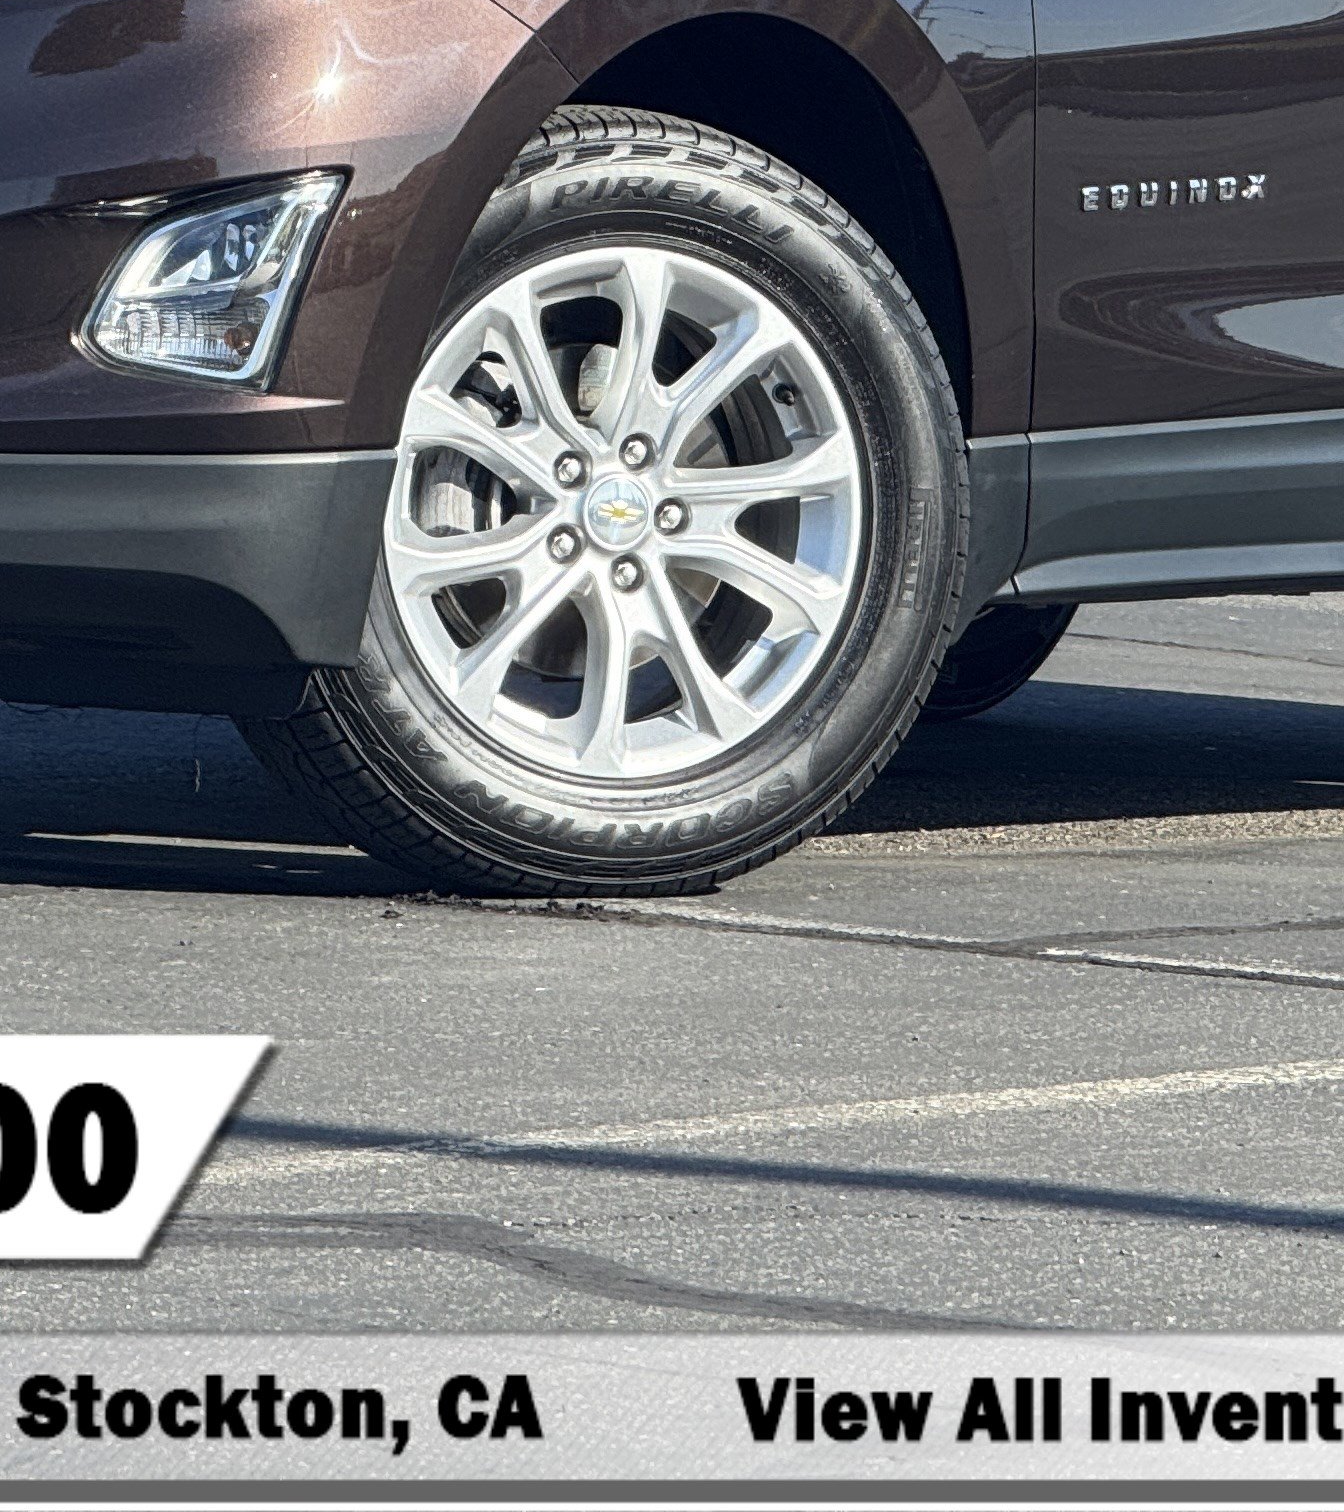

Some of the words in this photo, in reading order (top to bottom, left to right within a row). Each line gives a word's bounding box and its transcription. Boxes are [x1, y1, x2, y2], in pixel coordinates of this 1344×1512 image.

[549, 175, 795, 244] PIRELLI
[1082, 174, 1265, 211] EQUINOX
[454, 772, 795, 851] SCORPION
